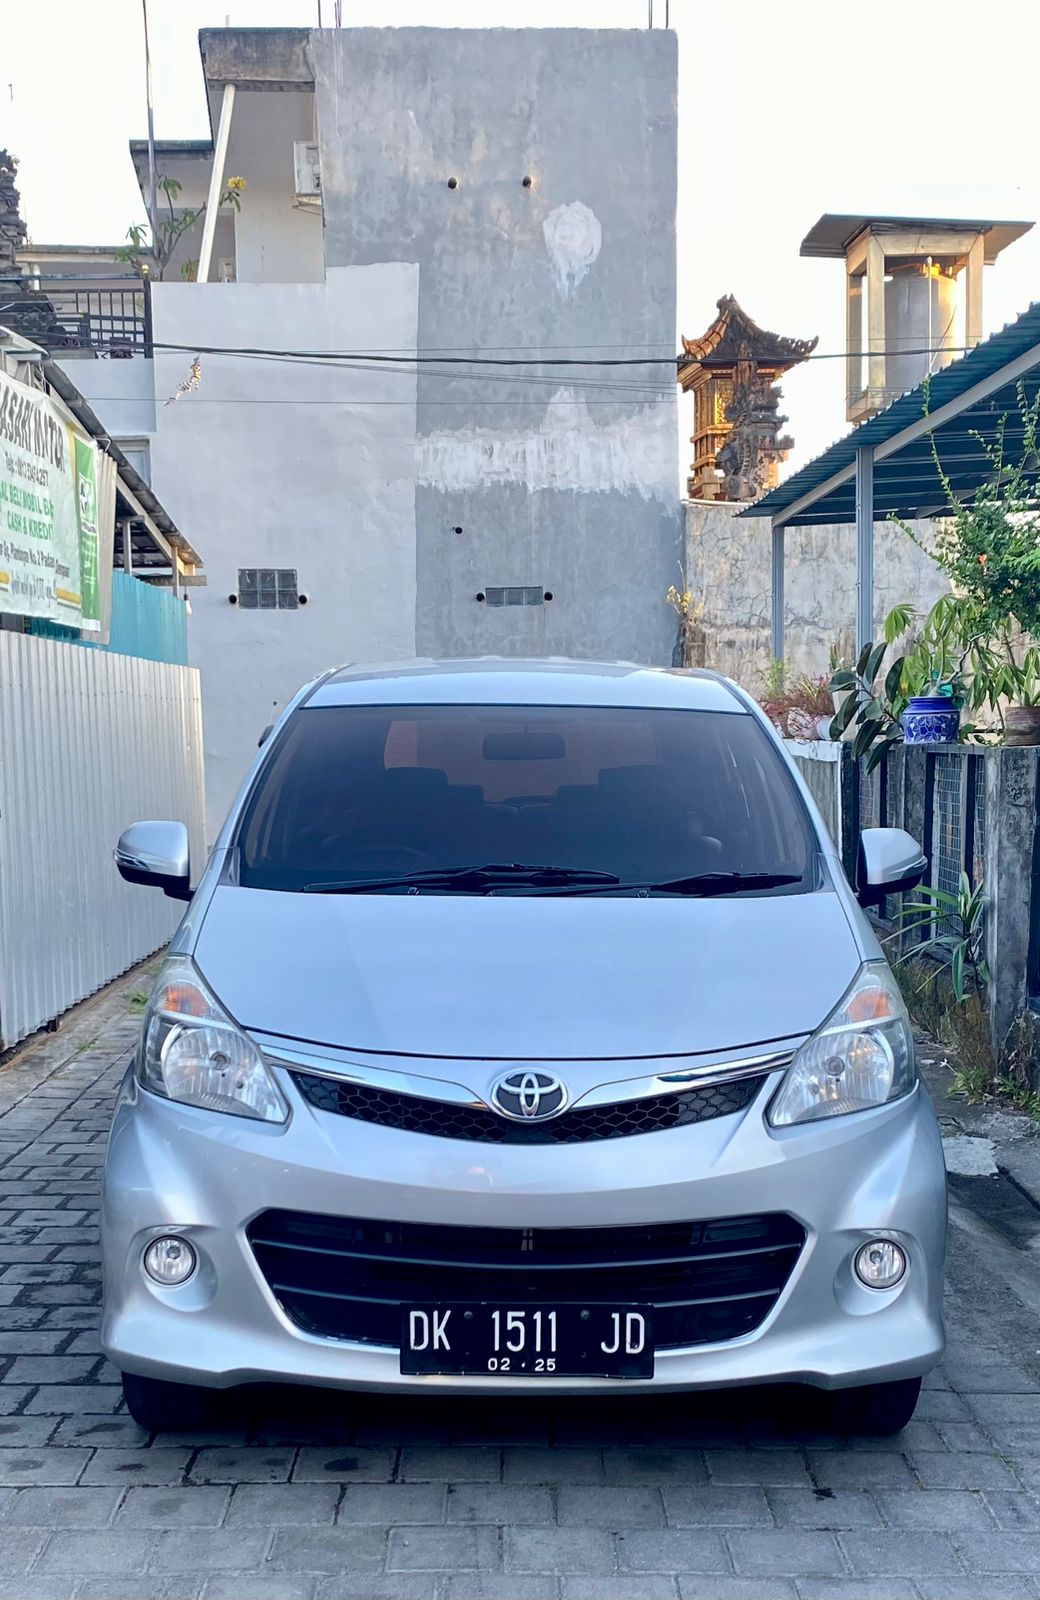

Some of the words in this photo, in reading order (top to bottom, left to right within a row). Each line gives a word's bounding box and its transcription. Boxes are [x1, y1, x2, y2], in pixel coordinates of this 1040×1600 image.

[7, 510, 22, 533] CASH
[23, 516, 28, 535] &
[409, 1310, 451, 1351] DK
[491, 1310, 557, 1353] 1511
[601, 1313, 646, 1354] JD
[488, 1358, 511, 1371] 02
[534, 1358, 556, 1372] 25
